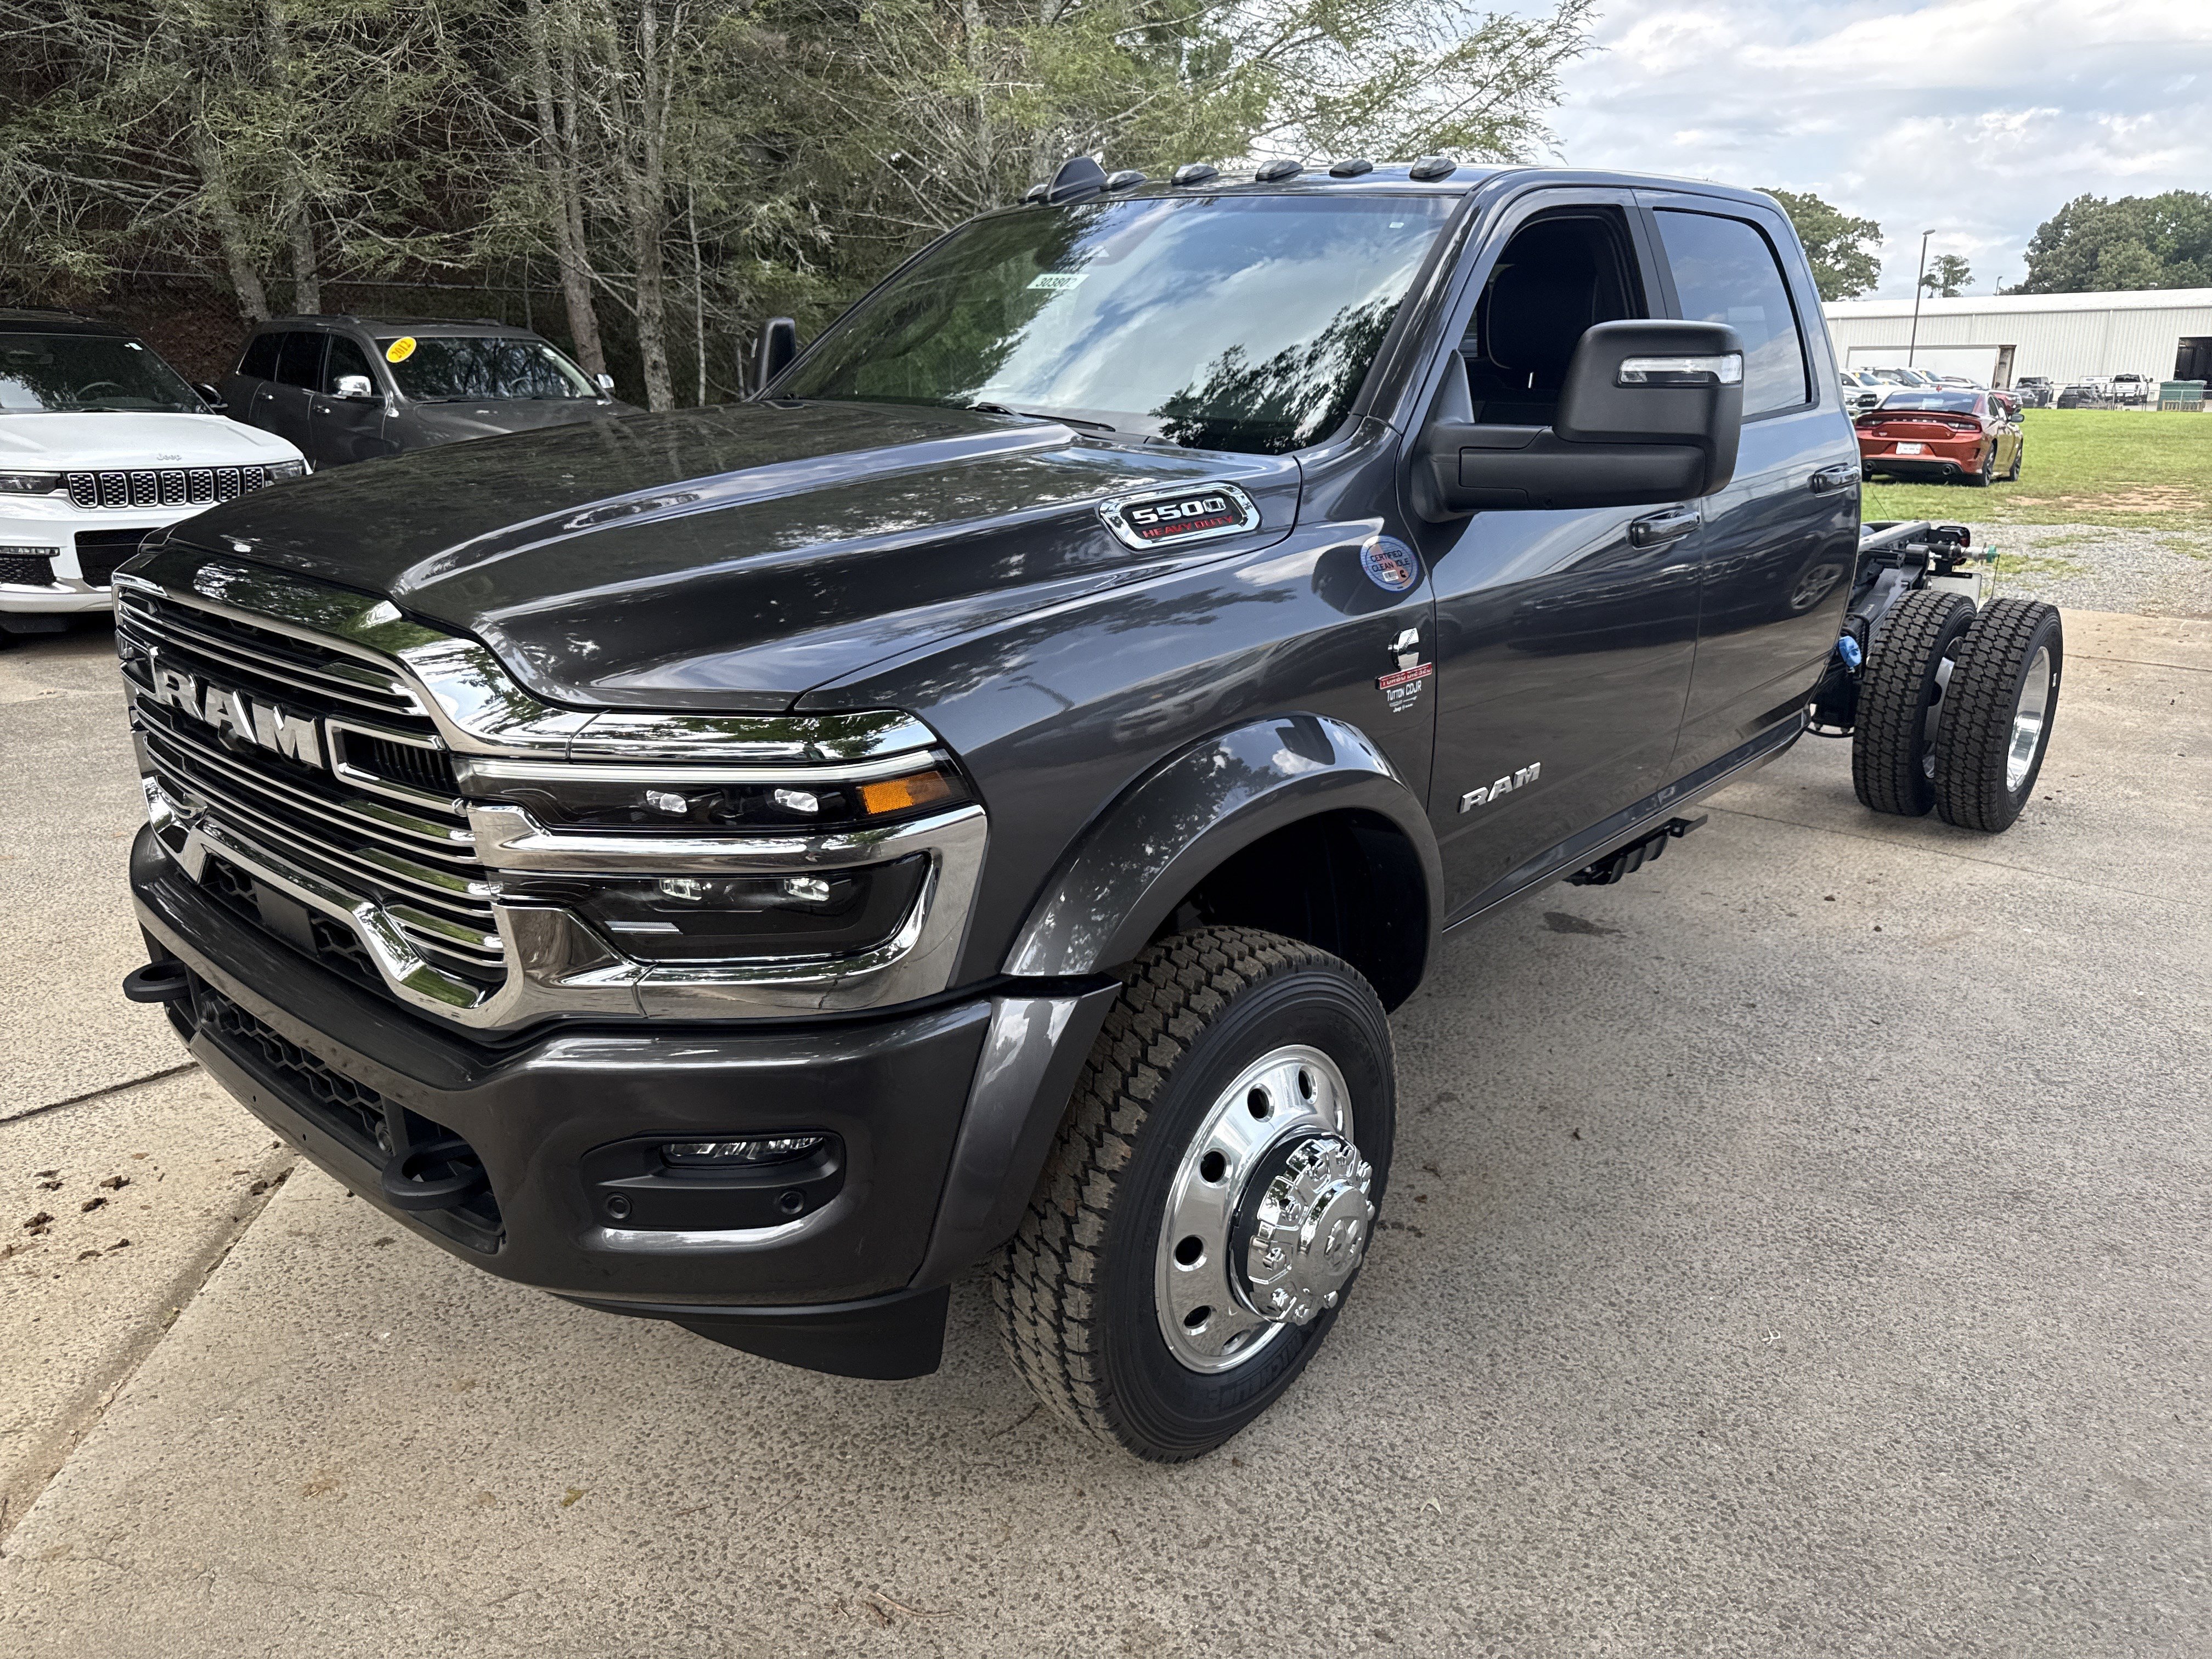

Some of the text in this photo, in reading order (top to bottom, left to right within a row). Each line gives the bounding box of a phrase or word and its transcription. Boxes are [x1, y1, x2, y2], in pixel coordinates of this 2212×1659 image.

[1035, 277, 1077, 287] 303802
[391, 340, 411, 359] 2012
[157, 453, 182, 461] Jeep
[1132, 497, 1227, 524] 5500
[1142, 516, 1234, 539] HEAVY DUTY
[1370, 550, 1403, 562] CERTIFIED
[1372, 558, 1410, 572] CLEAN IDLE
[1386, 687, 1404, 702] TUTTON
[1406, 680, 1422, 696] CDJR
[155, 667, 324, 769] RAM
[1459, 761, 1541, 814] RAM
